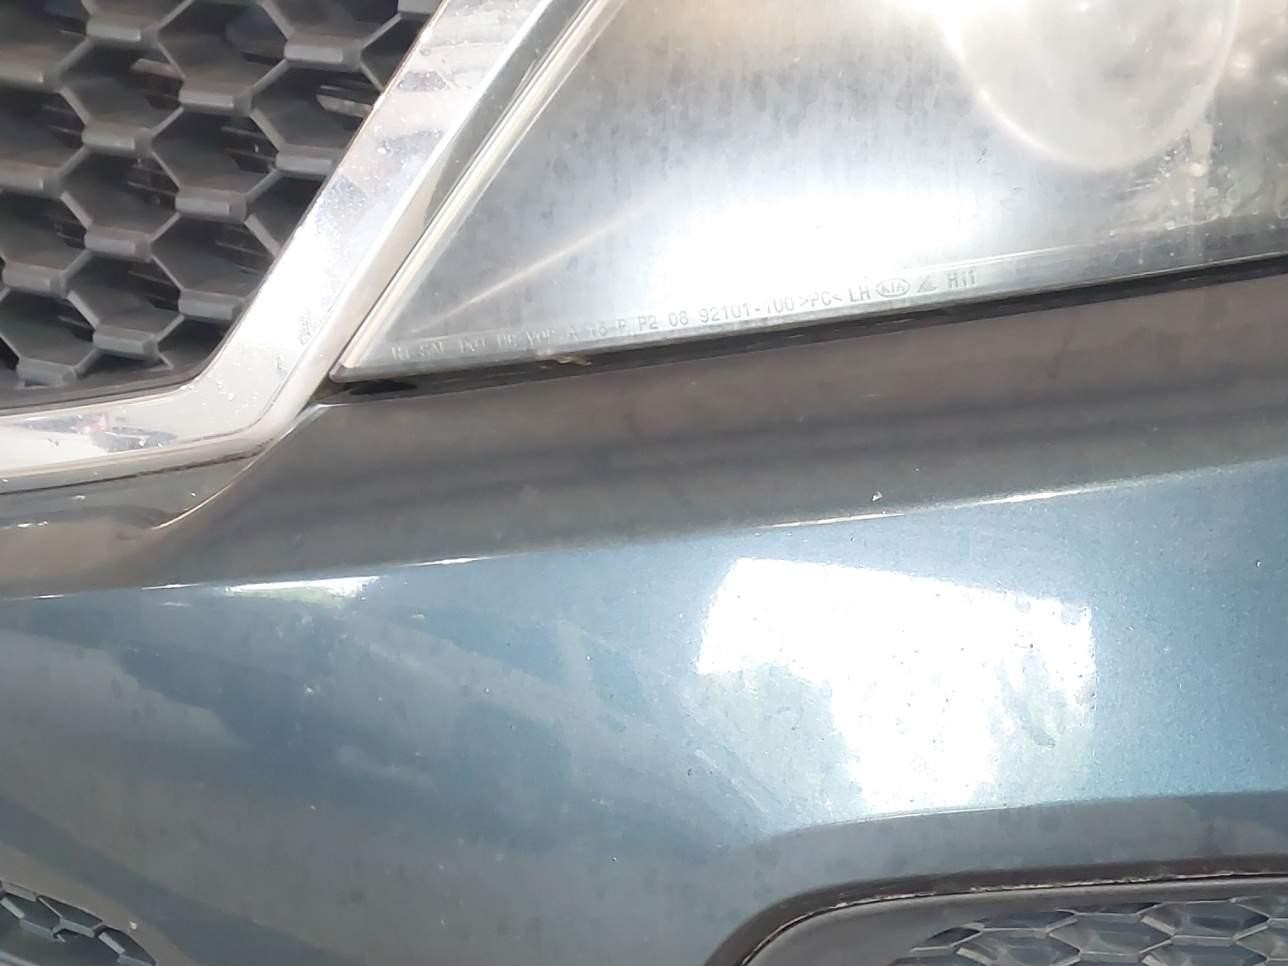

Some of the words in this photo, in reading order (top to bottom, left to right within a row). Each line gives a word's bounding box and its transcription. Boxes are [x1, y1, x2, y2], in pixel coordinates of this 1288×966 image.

[638, 314, 659, 331] P2
[669, 310, 690, 328] 08
[847, 284, 872, 304] LH
[879, 280, 908, 296] KIA
